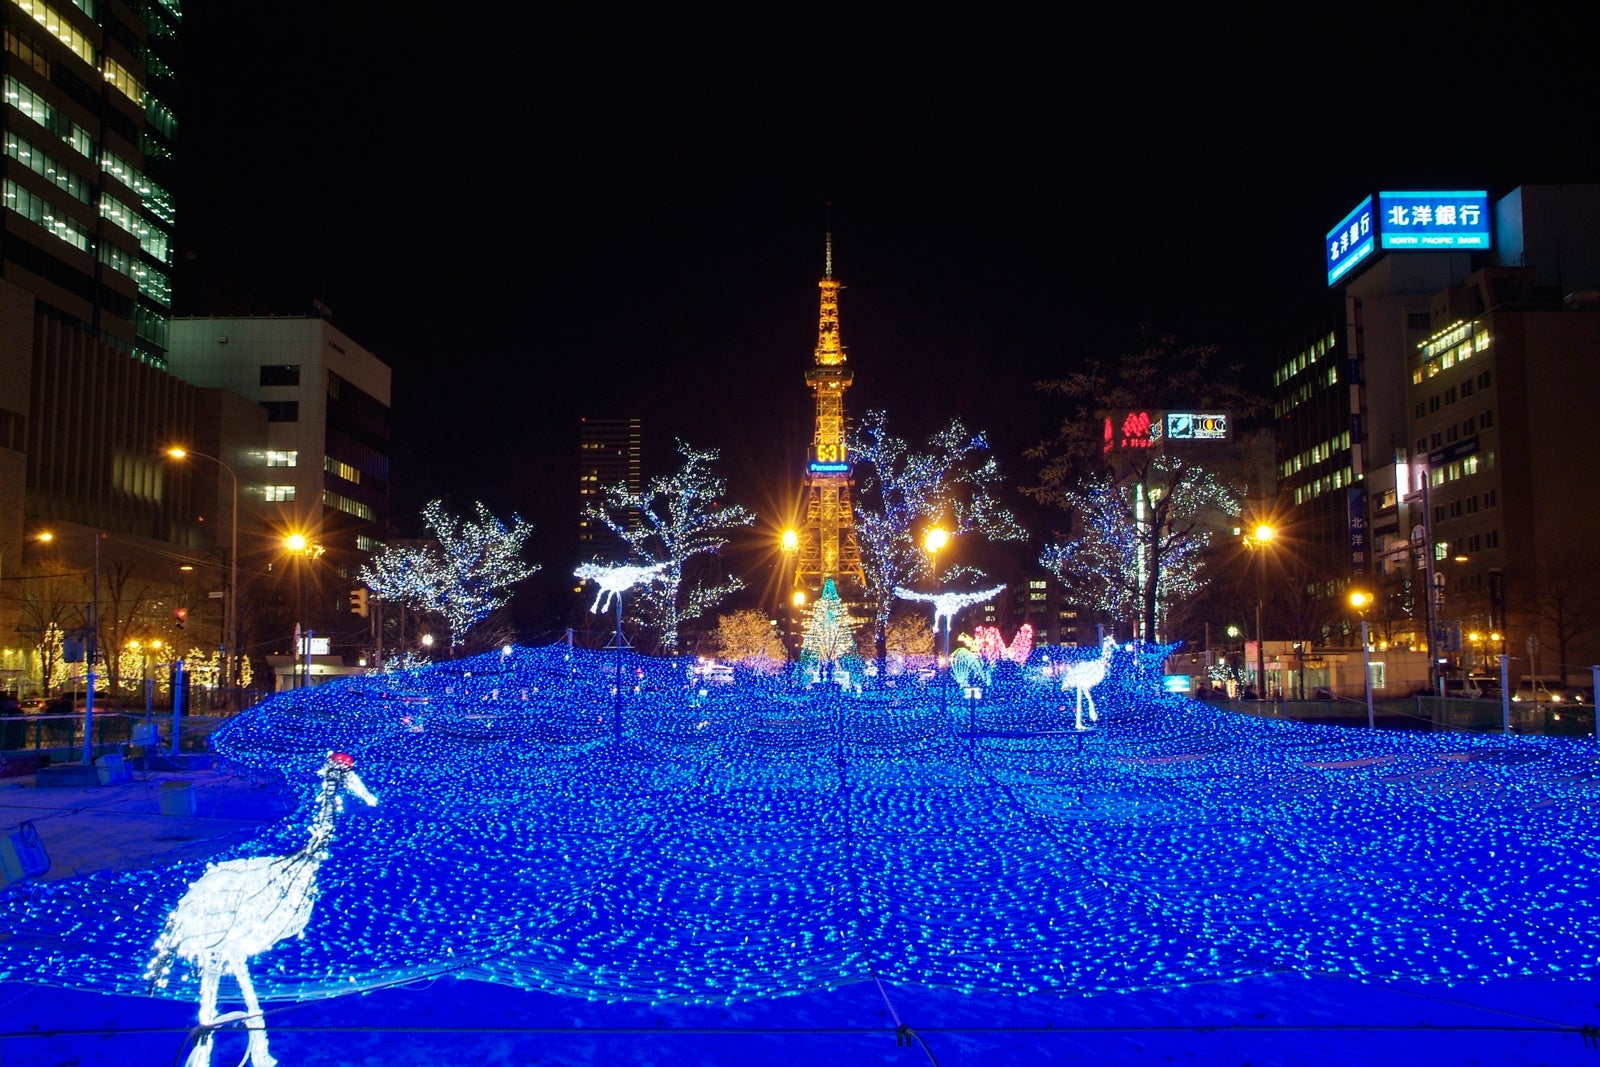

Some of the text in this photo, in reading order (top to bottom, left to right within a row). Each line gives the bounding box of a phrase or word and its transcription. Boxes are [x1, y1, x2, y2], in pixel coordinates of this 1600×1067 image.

[1388, 205, 1481, 226] 北洋銀行
[1331, 213, 1370, 260] 北洋銀行
[1389, 236, 1481, 245] NORTH PACIFIC BANK
